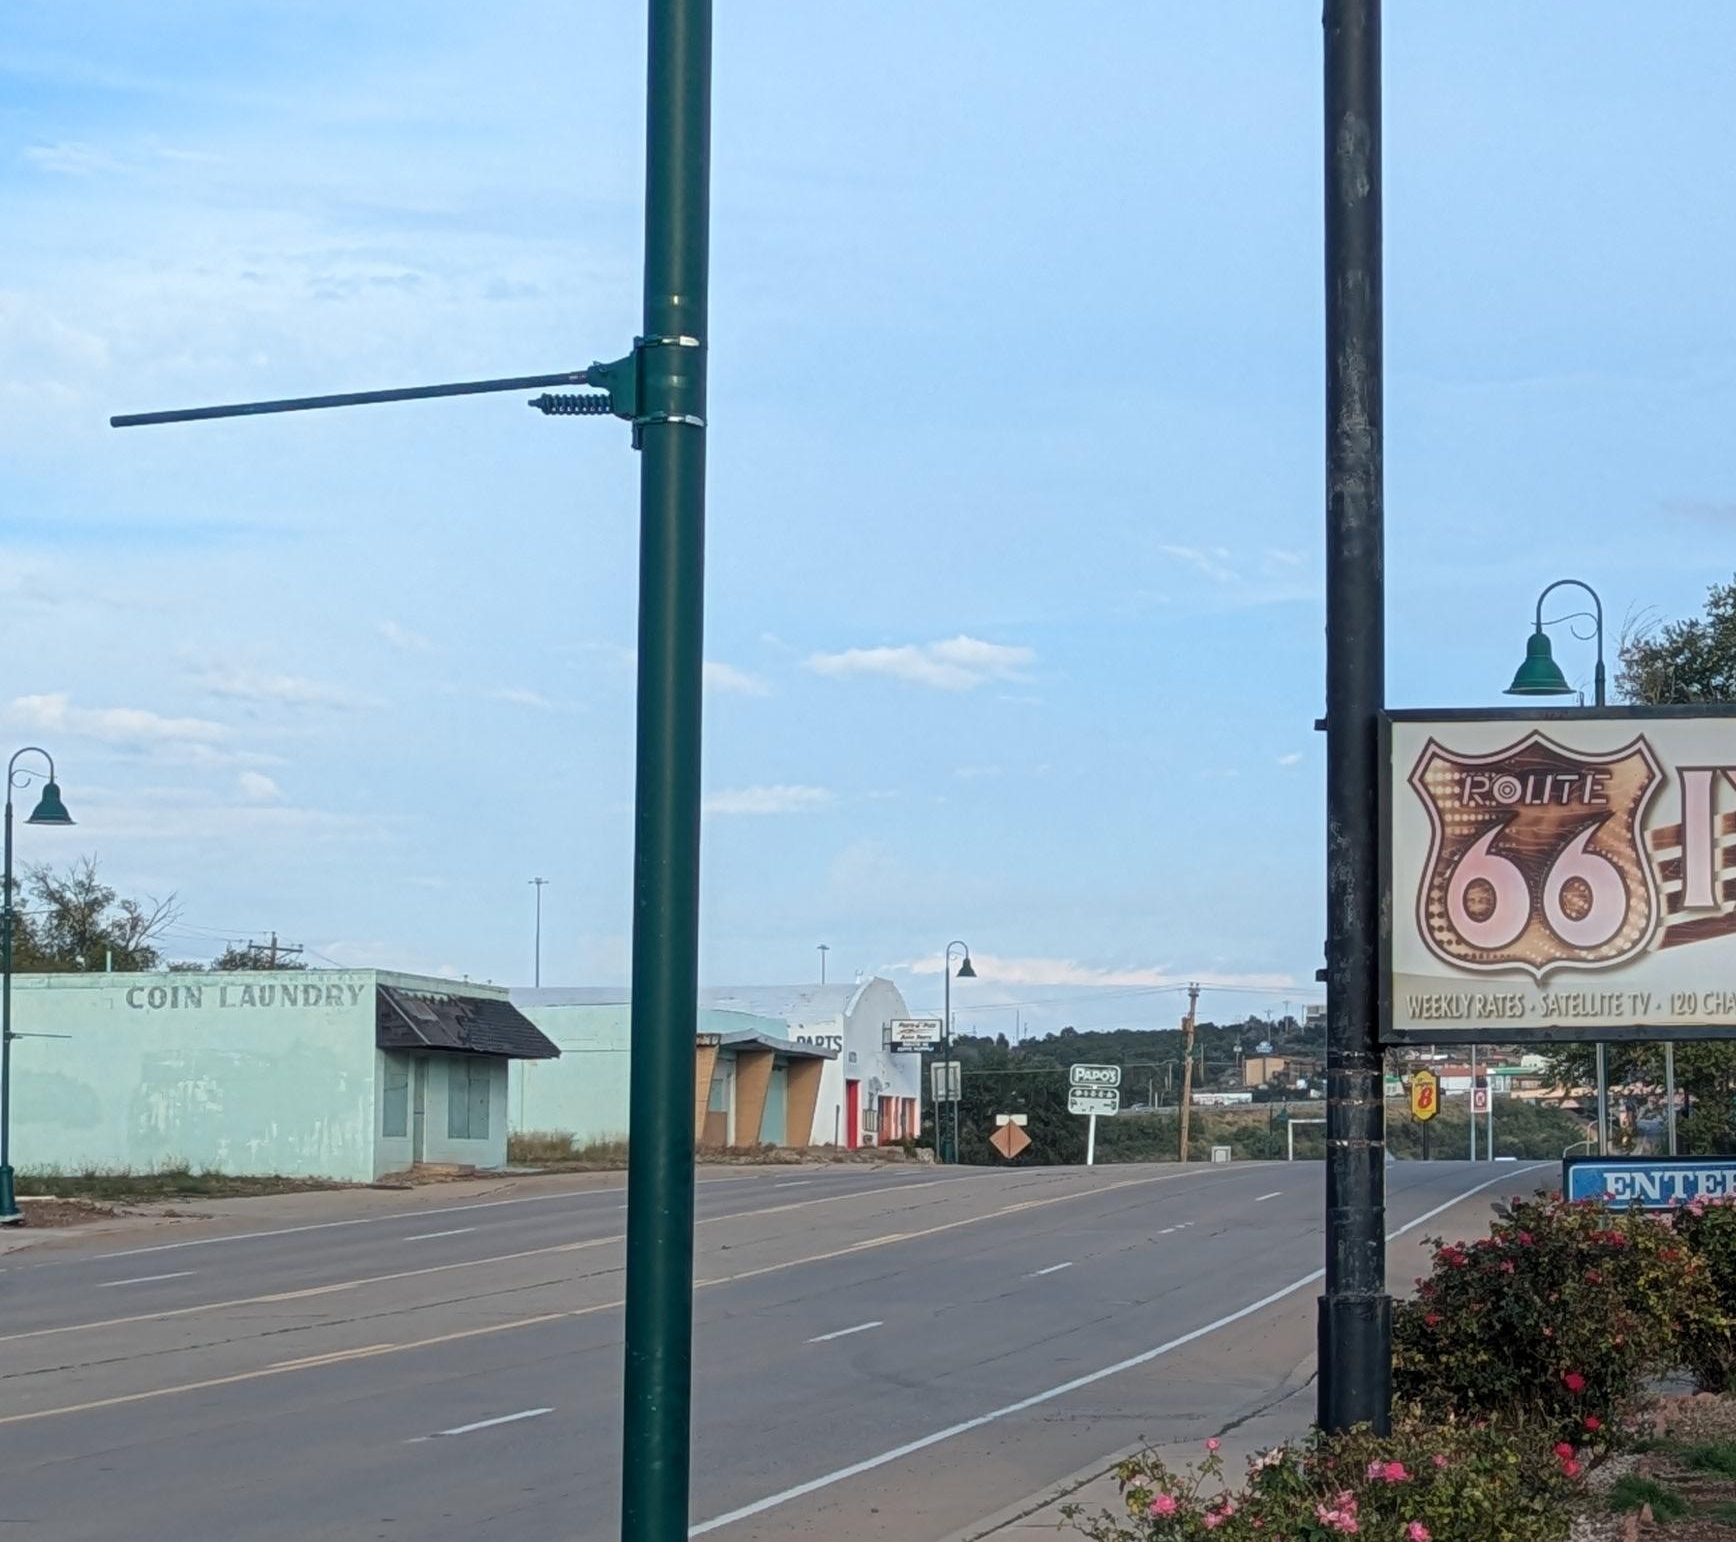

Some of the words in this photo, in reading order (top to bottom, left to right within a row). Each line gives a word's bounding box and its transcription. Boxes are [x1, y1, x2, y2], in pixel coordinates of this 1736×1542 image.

[1461, 772, 1612, 806] ROUTE
[1446, 812, 1630, 950] 66
[125, 985, 202, 1009] COIN
[219, 983, 366, 1008] LAUNDRY
[1407, 994, 1474, 1019] WEEKLY
[1475, 994, 1525, 1019] RATES
[1540, 993, 1624, 1018] SATELLITE
[1629, 992, 1651, 1016] TV
[1670, 992, 1698, 1016] 120
